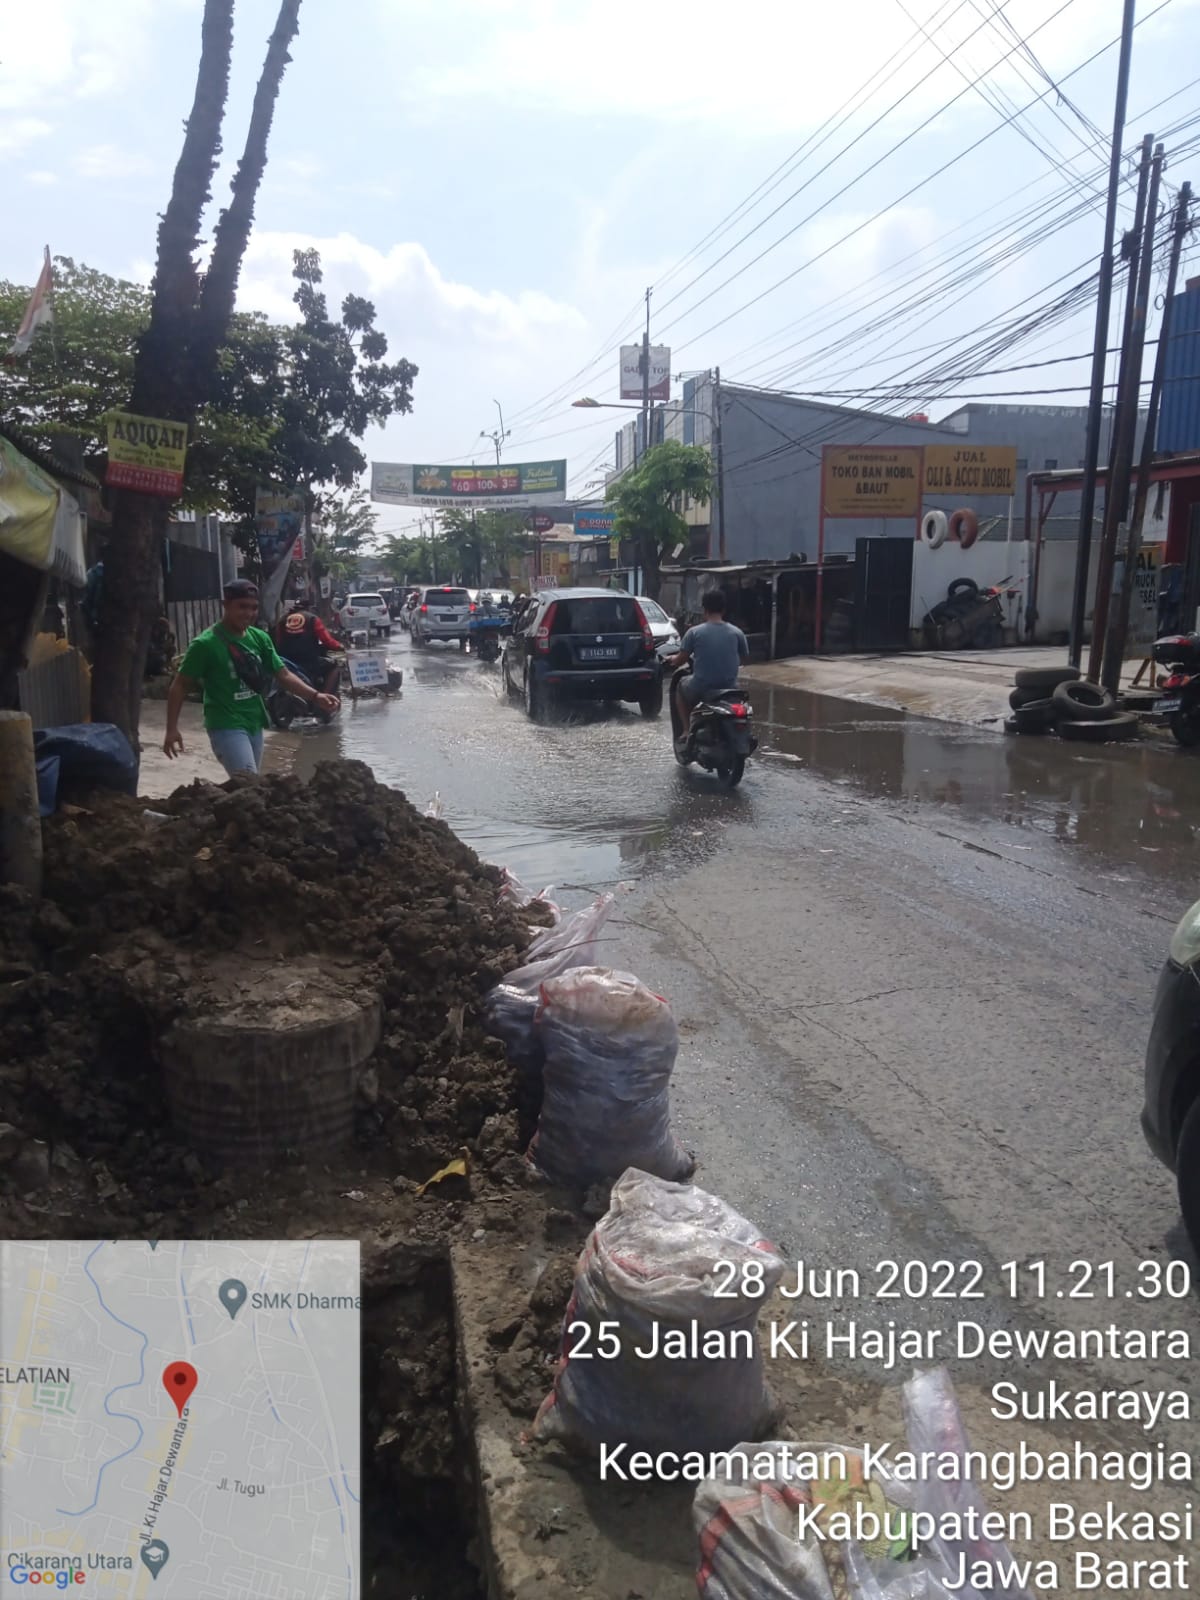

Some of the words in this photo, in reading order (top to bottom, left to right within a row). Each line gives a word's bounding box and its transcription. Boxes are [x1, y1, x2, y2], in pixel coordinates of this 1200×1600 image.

[113, 420, 184, 450] AQIQAH
[953, 451, 987, 462] JUAL
[832, 466, 858, 478] TOKO
[862, 466, 882, 478] BAN
[885, 467, 915, 479] MOBIL
[954, 467, 980, 488] ACCU
[982, 468, 1012, 489] MOBIL
